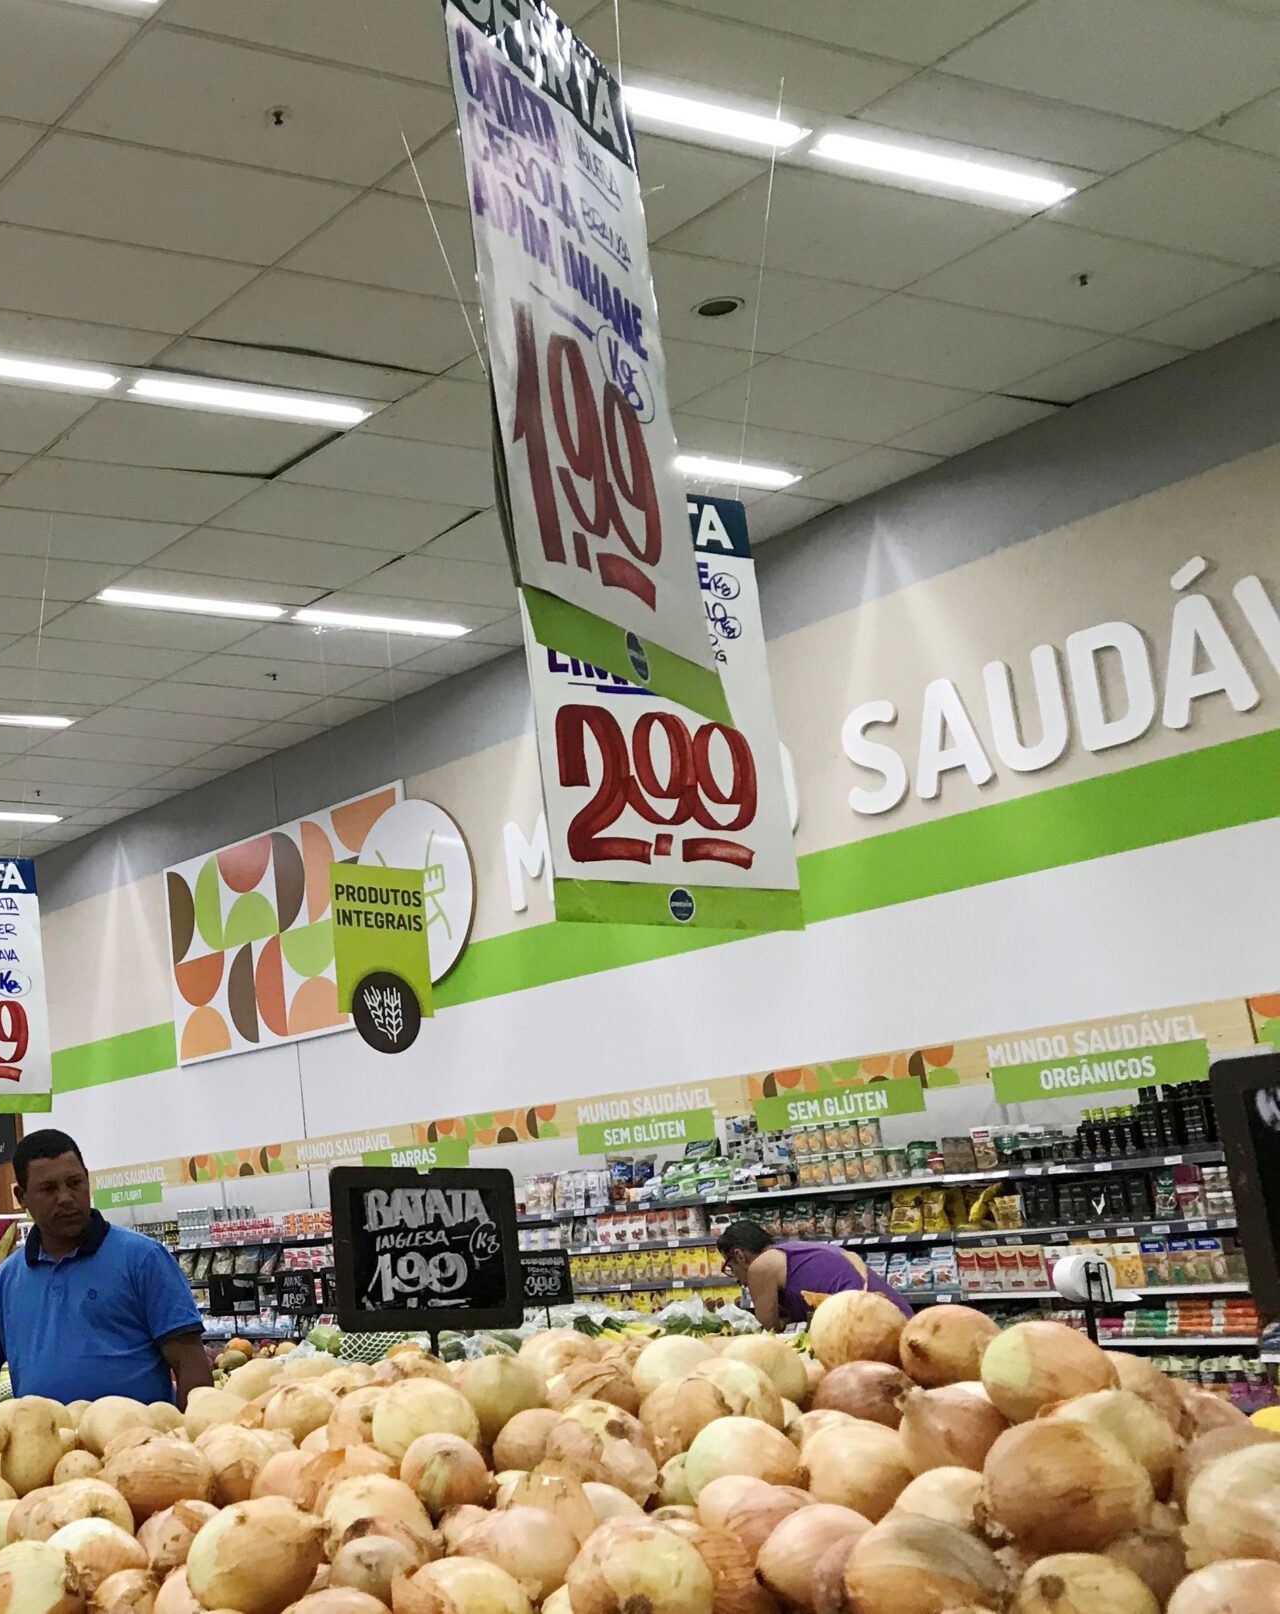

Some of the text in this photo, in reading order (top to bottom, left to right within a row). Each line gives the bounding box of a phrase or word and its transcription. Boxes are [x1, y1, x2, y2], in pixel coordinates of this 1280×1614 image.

[334, 884, 422, 907] PRODUTOS
[336, 909, 423, 932] INTEGRAIS
[987, 1013, 1206, 1067] MUNDO SAUDÁVEL
[1040, 1055, 1156, 1090] ORGÂNICOS
[577, 1086, 716, 1124] MUNDO SAUDÁVEL
[787, 1088, 888, 1122] SEM GLÚTEN
[296, 1132, 394, 1161] MUNDO SAUDÁVEL
[603, 1118, 686, 1146] SEM GLÚTEN
[391, 1147, 437, 1167] BARRAS
[363, 1188, 490, 1232] BATATA
[376, 1230, 449, 1252] INGLESA
